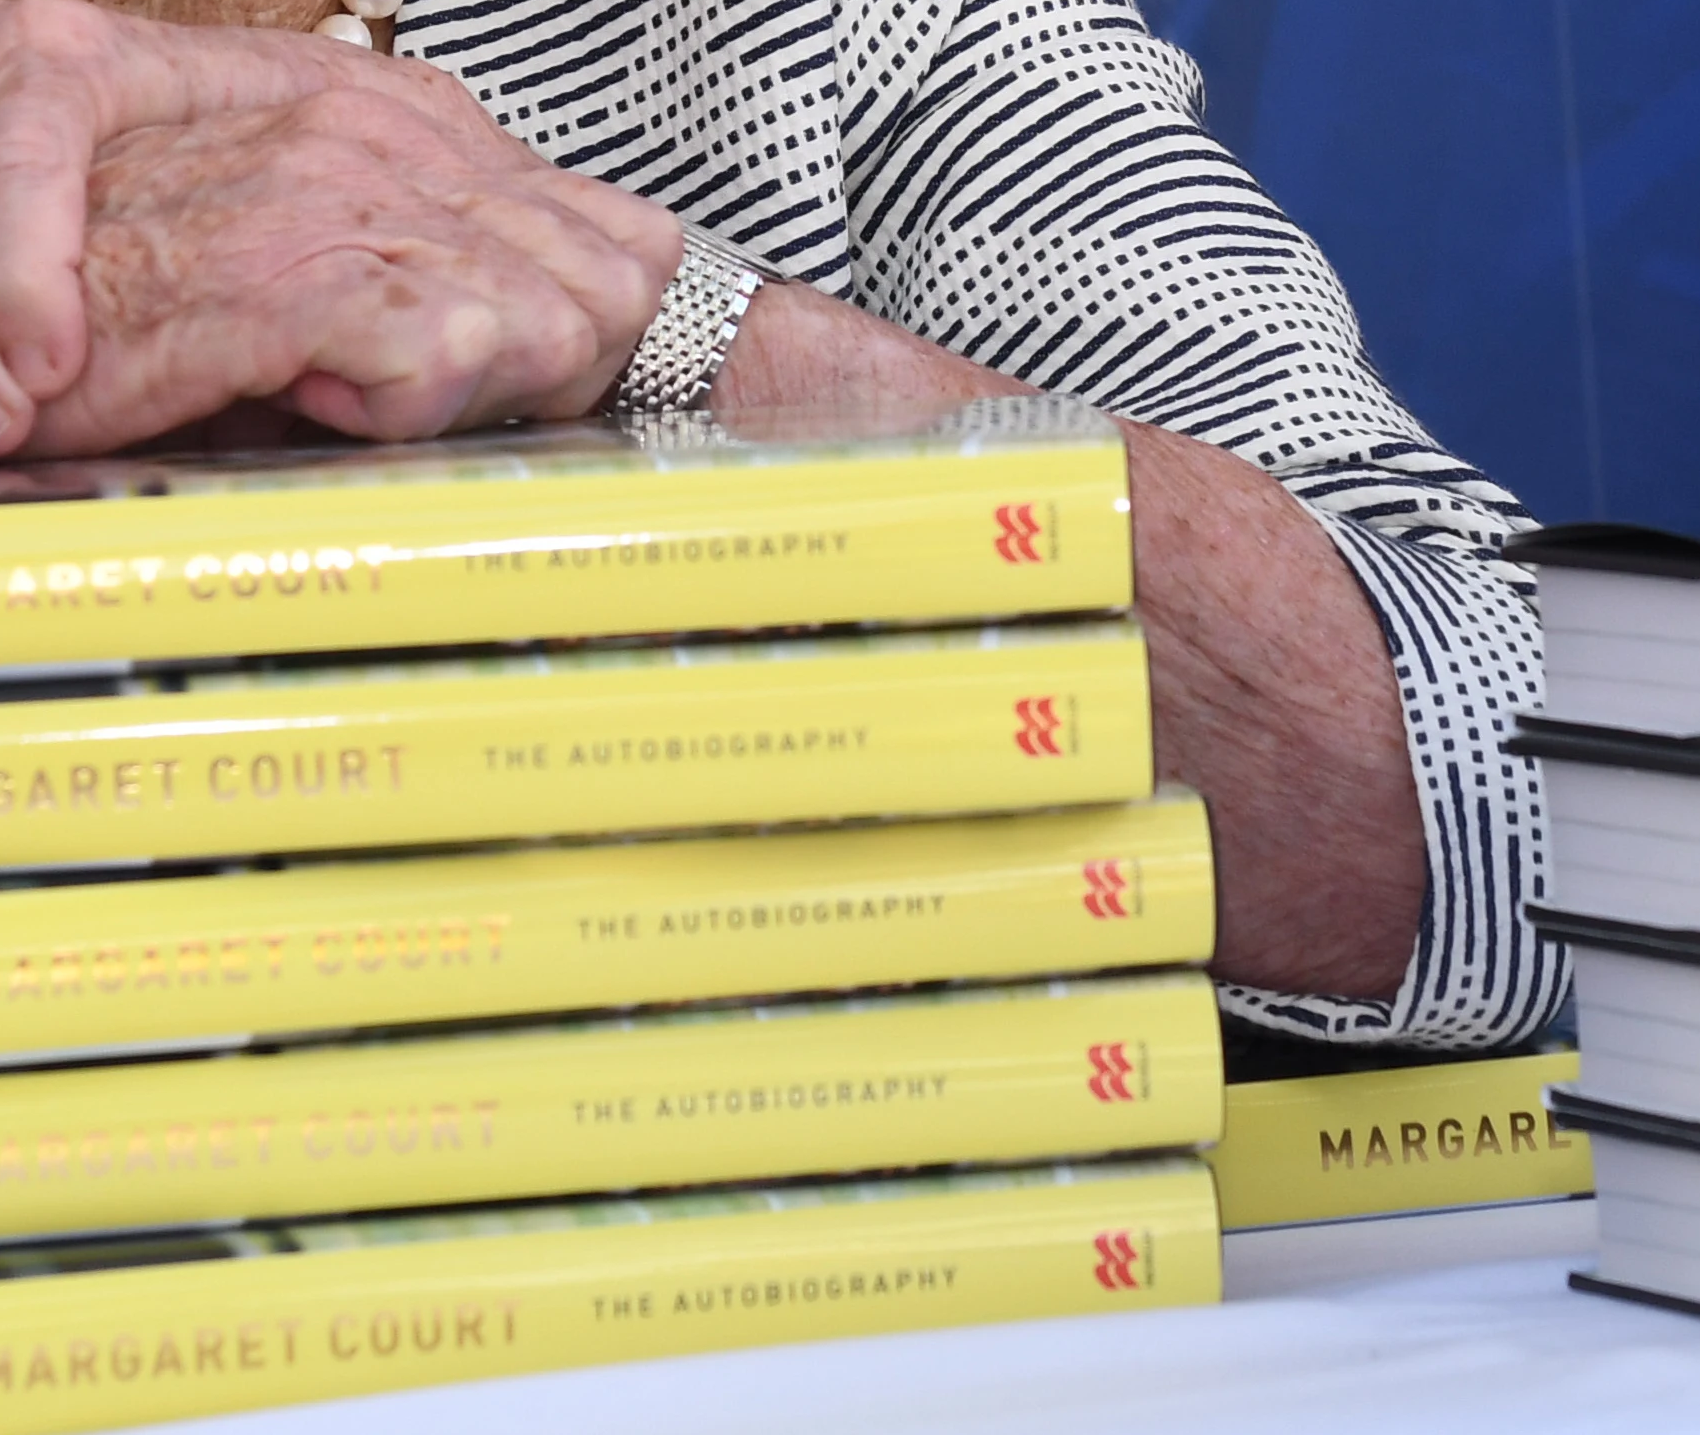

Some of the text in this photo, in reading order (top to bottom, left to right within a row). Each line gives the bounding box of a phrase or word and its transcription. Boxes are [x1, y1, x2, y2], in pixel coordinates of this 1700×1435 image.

[184, 535, 395, 602] COURT
[548, 531, 851, 569] AUTOBIOGRAPHY
[208, 745, 410, 802] COURT
[483, 742, 549, 771] THE
[568, 726, 870, 767] AUTOBIOGRAPHY
[311, 913, 511, 976] COURT
[578, 912, 641, 941] THE
[658, 893, 947, 936] AUTOBIOGRAPHY
[300, 1099, 500, 1160] COURT
[573, 1099, 635, 1124] THE
[655, 1076, 949, 1120] AUTOBIOGRAPHY
[327, 1297, 521, 1363] COURT
[593, 1295, 653, 1321] THE
[673, 1266, 958, 1313] AUTOBIOGRAPHY
